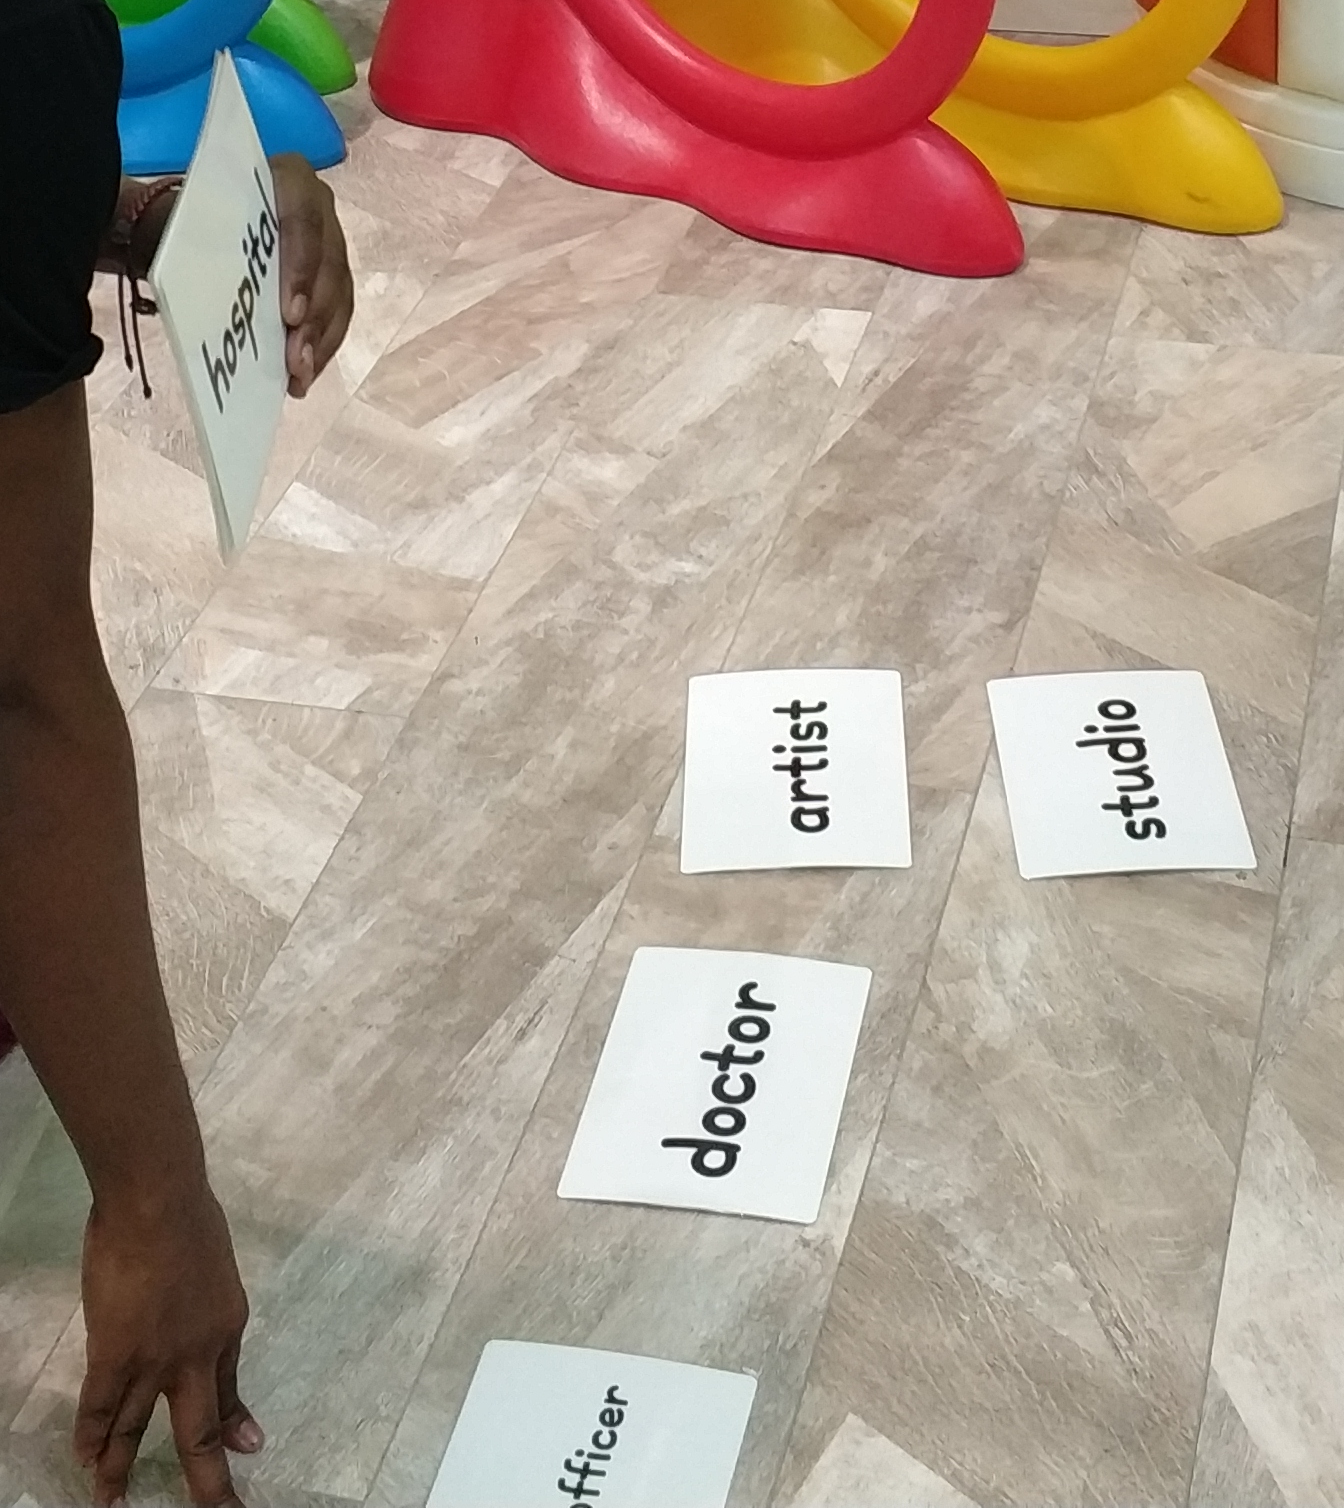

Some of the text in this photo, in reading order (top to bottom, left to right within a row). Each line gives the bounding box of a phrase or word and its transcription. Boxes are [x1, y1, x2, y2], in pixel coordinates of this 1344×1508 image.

[201, 166, 279, 414] hospital
[771, 699, 830, 833] artist
[1075, 698, 1167, 840] studio
[661, 981, 777, 1178] doctor
[557, 1385, 629, 1508] fficer
